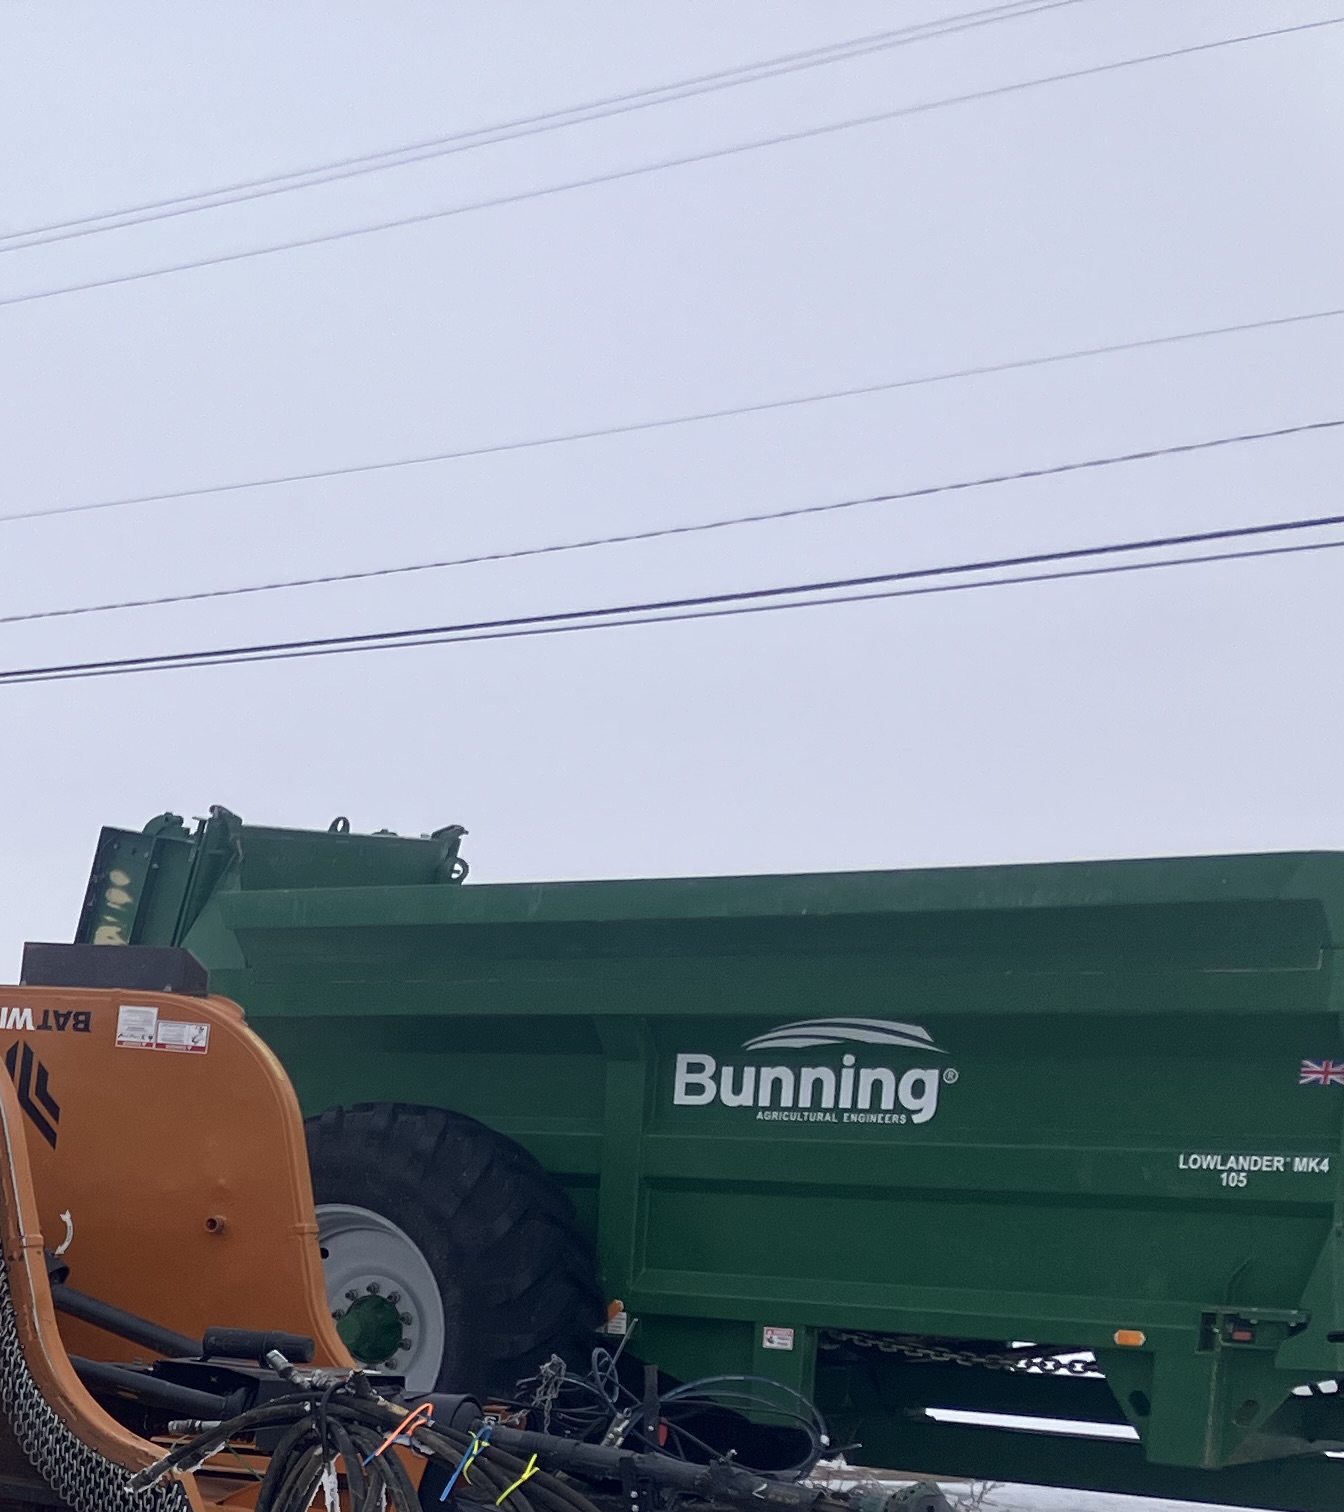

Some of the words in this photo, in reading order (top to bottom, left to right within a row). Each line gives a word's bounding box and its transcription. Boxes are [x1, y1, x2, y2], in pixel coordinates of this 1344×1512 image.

[756, 1111, 838, 1123] AGRICULTURAL
[843, 1113, 907, 1125] ENGINEERS
[1293, 1156, 1330, 1173] MK4
[1220, 1172, 1248, 1187] 105
